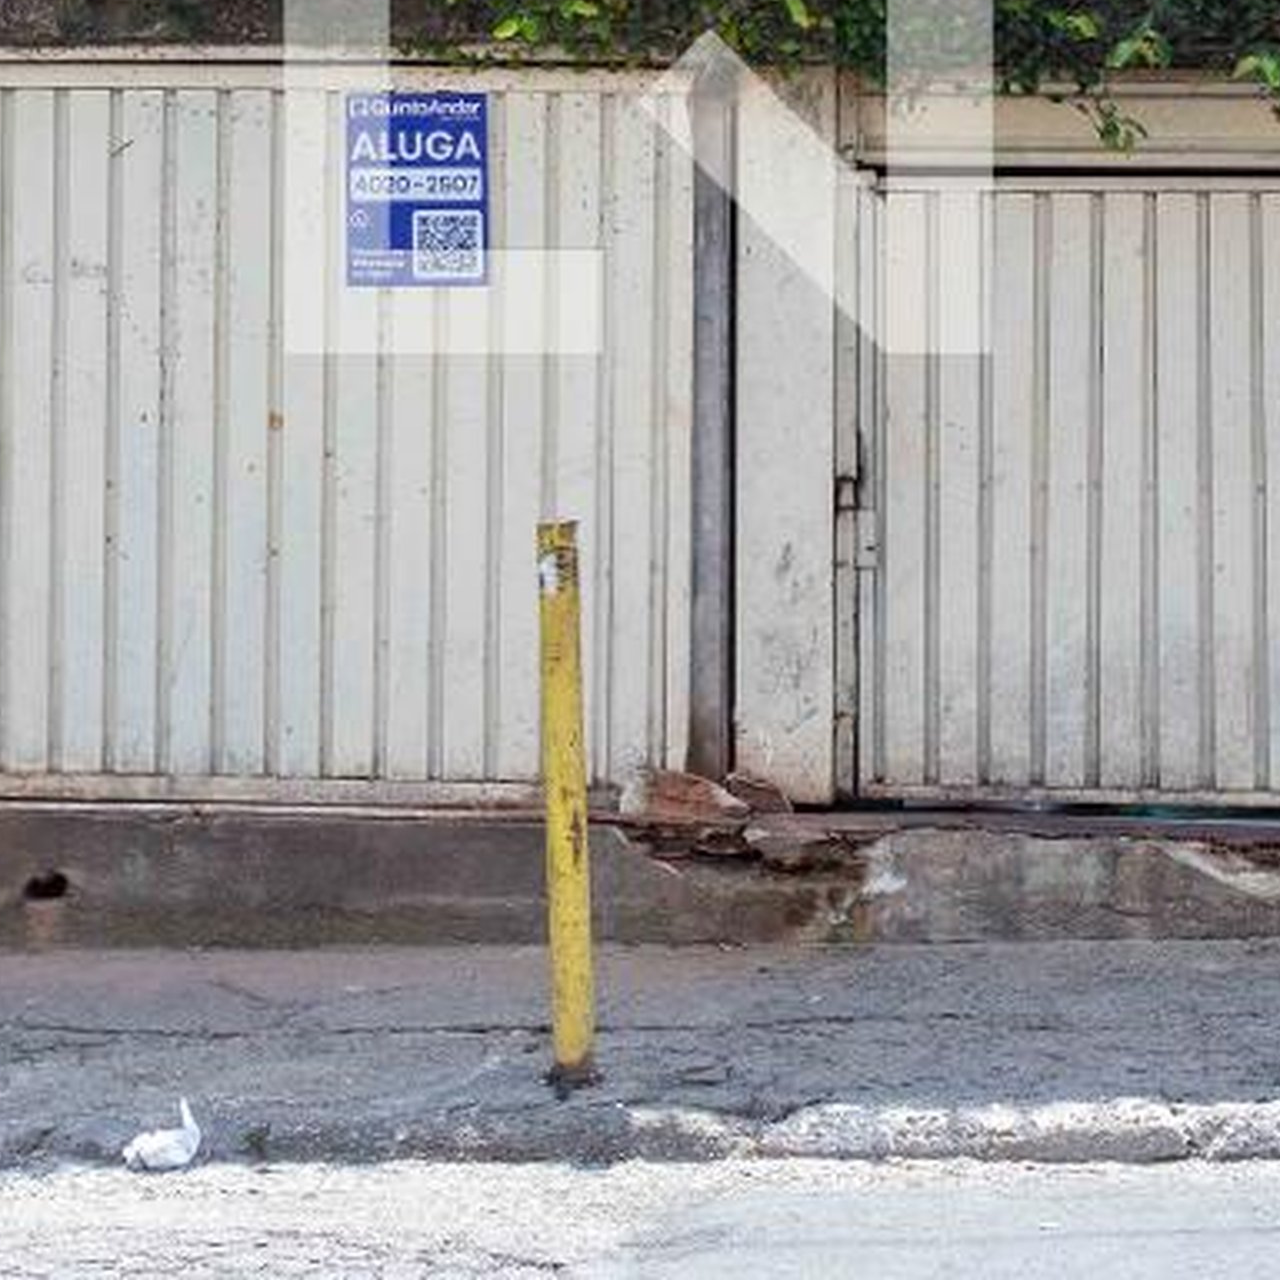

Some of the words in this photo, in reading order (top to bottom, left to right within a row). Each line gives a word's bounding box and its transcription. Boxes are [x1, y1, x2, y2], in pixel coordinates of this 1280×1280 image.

[370, 99, 481, 116] QuintoAndar
[351, 131, 481, 161] ALUGA
[355, 175, 478, 194] 4020-2507
